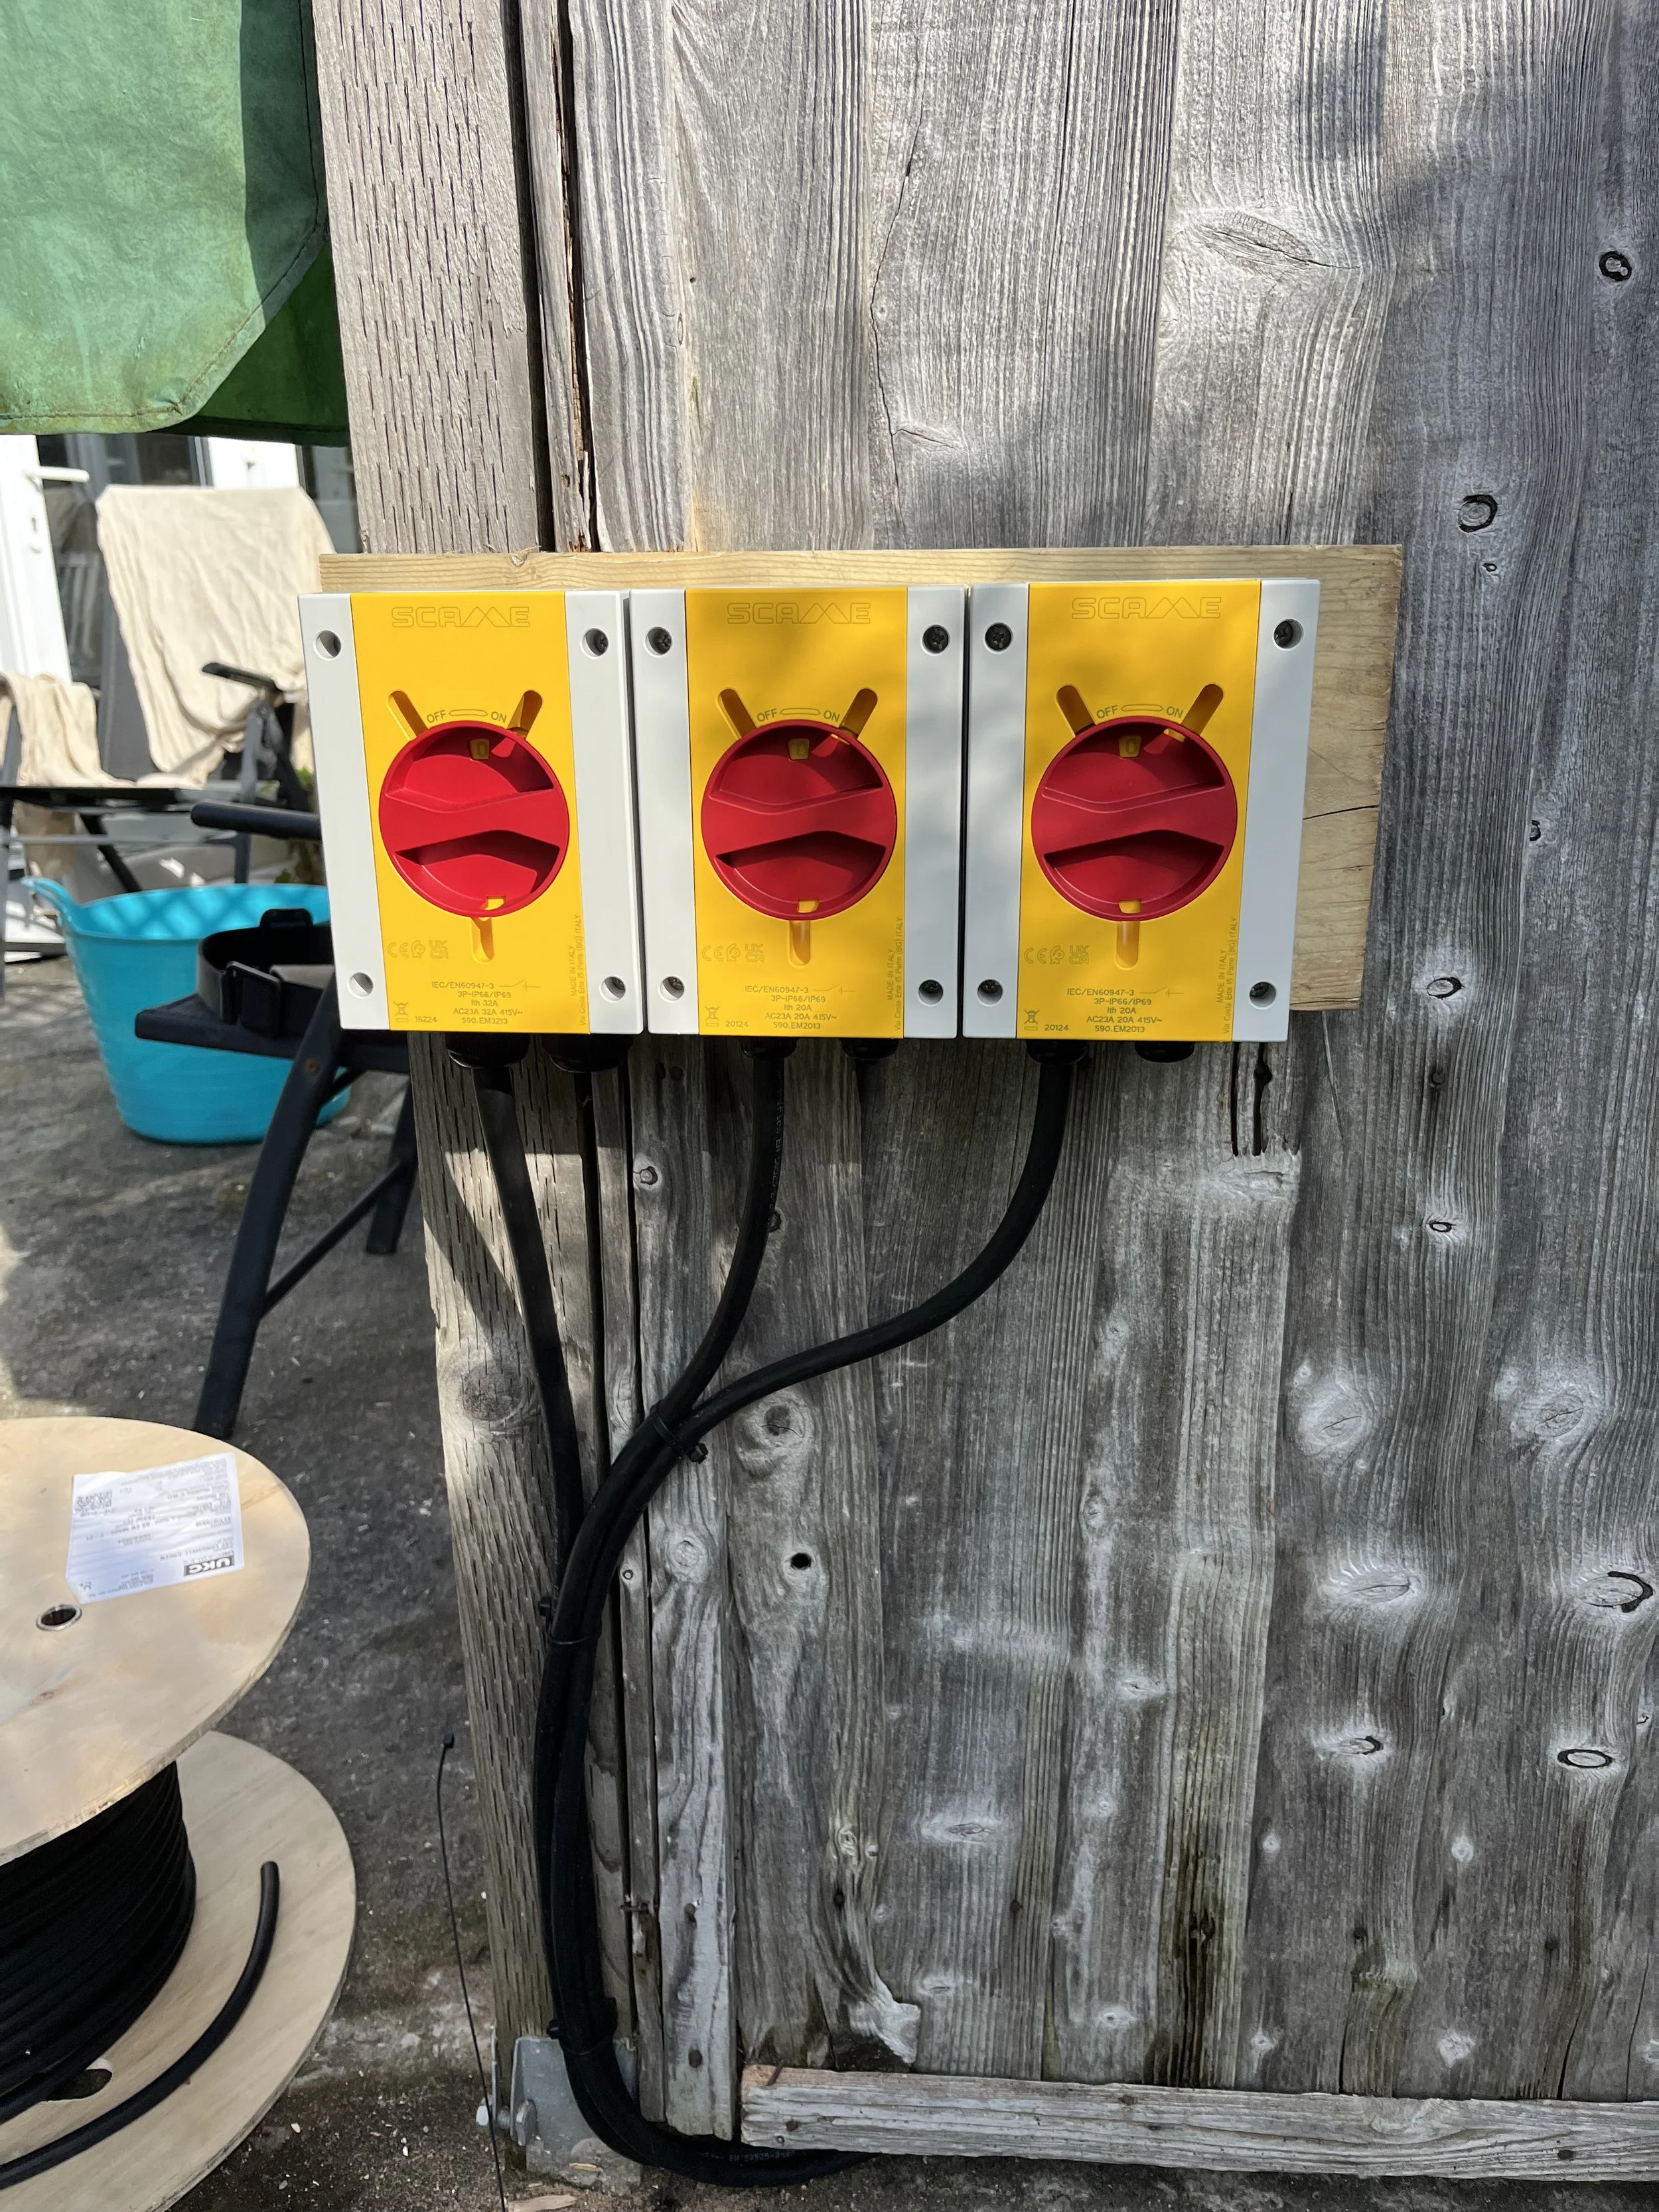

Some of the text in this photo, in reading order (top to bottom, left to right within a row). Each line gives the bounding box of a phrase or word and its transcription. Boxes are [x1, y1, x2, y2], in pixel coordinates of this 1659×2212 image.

[727, 603, 871, 624] SCAME
[1071, 597, 1222, 619] SCAME
[392, 606, 531, 628] SCAME
[427, 709, 507, 723] OFF ON
[757, 708, 840, 722] OFF ON
[1096, 705, 1183, 719] OFF ON
[745, 985, 809, 994] IEC/EN60947-3
[1066, 988, 1135, 996] IEC/EN60947-3
[1094, 997, 1152, 1006] 3P-IP66/IP69
